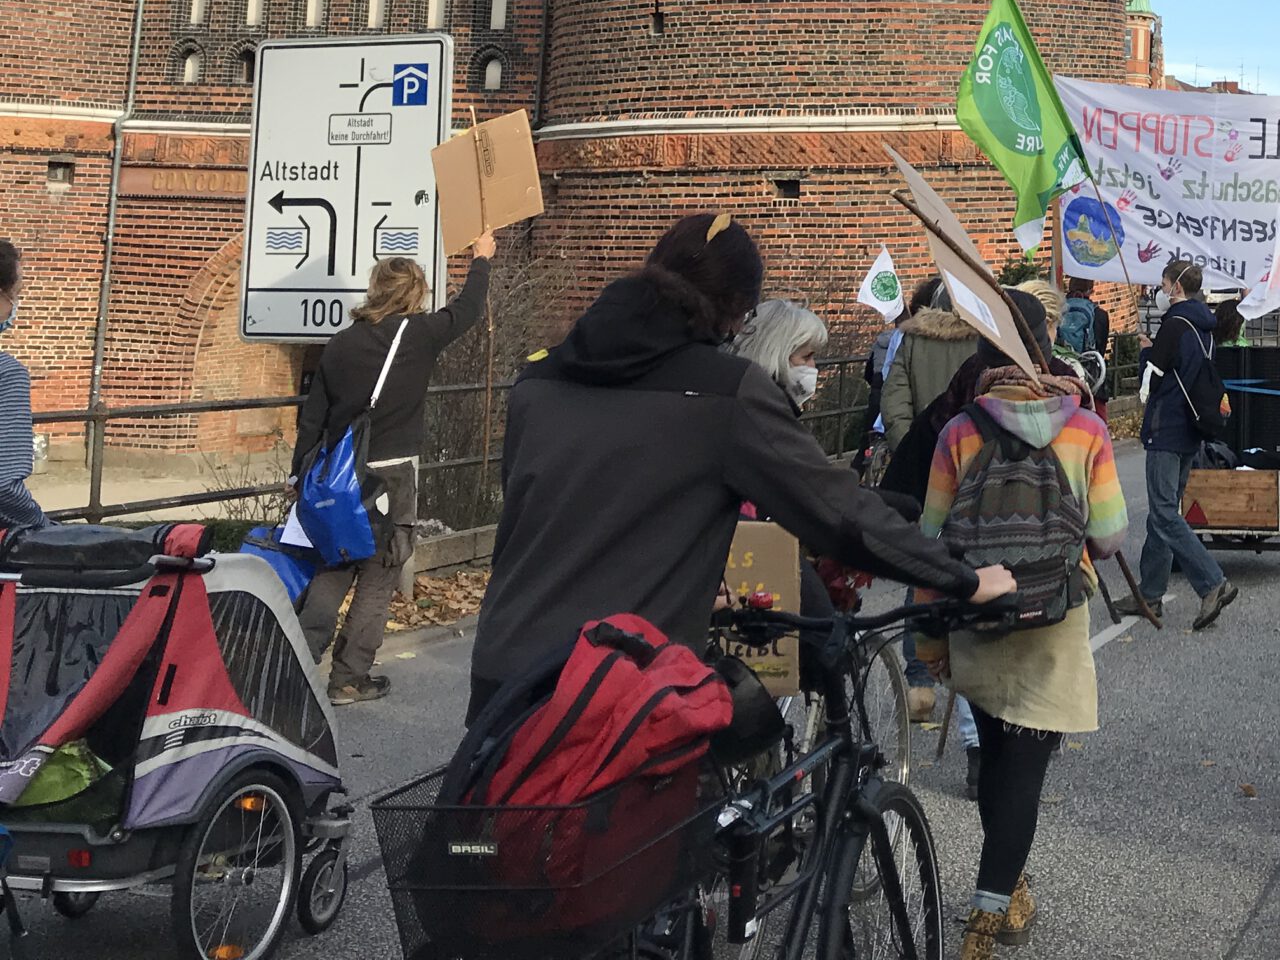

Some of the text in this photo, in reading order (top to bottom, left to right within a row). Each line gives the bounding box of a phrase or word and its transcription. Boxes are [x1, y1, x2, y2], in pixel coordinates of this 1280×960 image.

[403, 77, 420, 104] P
[347, 117, 374, 128] Altstadt
[330, 130, 389, 141] keine Durchfahrt!
[259, 160, 340, 181] Altstadt
[301, 299, 343, 327] 100
